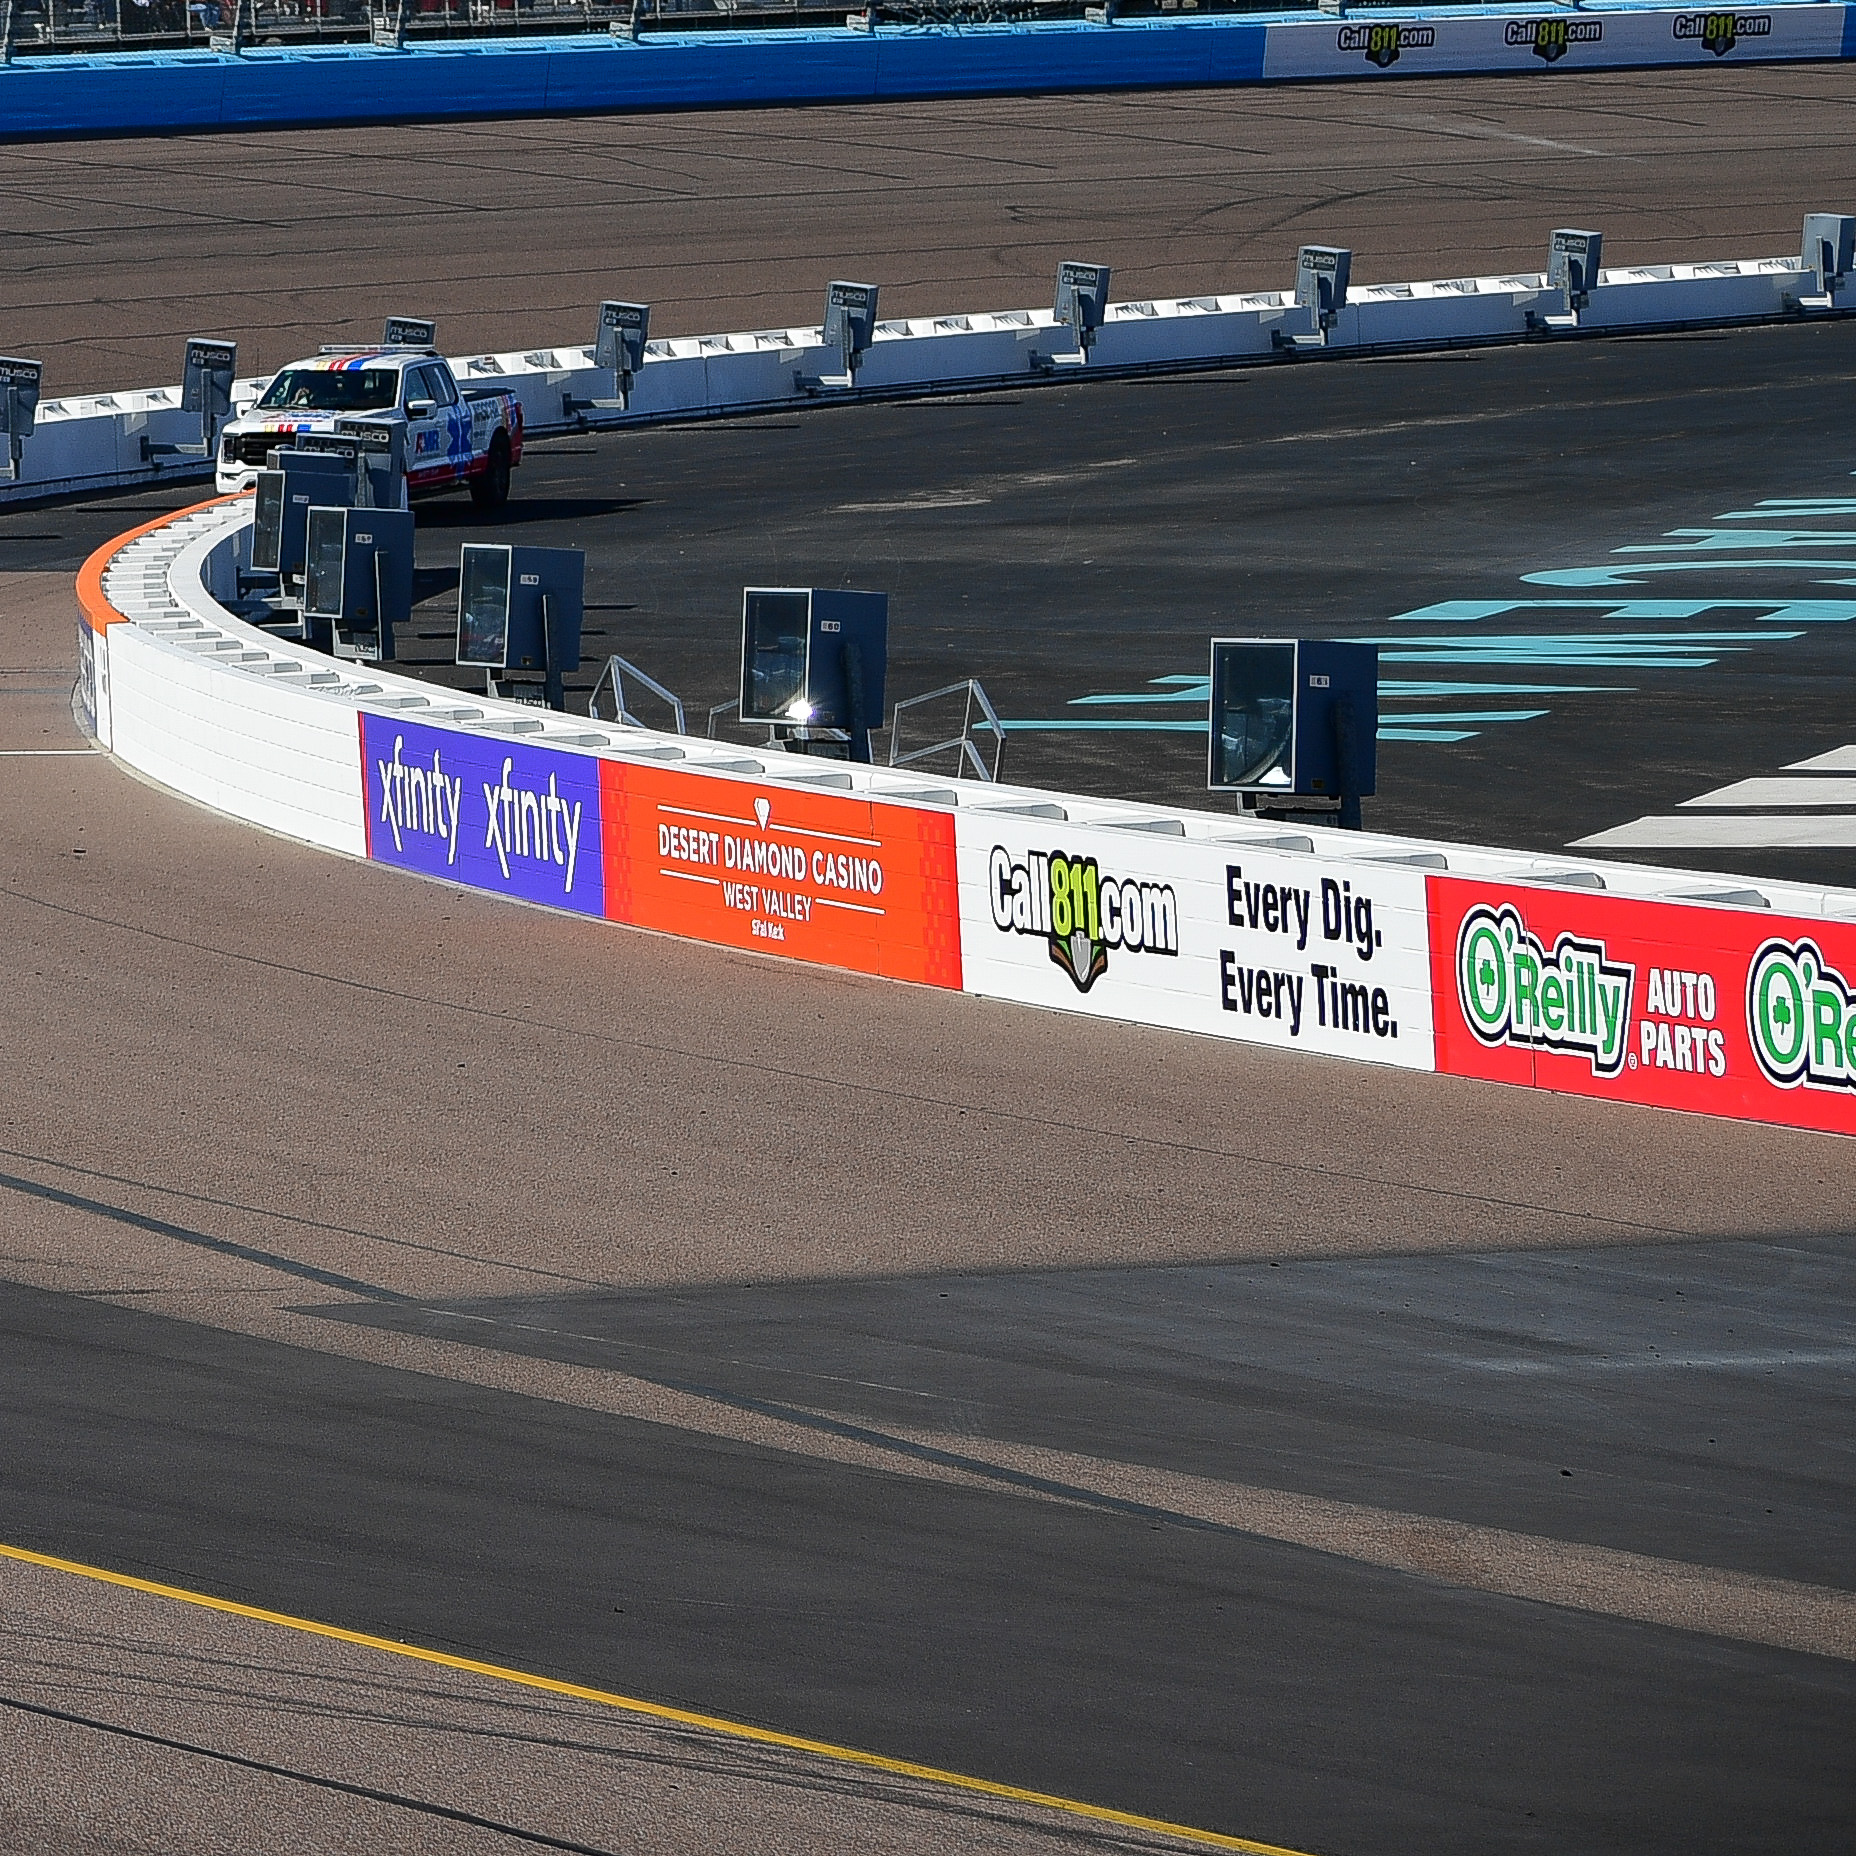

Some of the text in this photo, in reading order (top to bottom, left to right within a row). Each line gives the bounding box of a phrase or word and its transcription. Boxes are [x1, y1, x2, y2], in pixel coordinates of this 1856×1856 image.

[1338, 24, 1436, 52] Call811.com
[1505, 18, 1604, 47] Call811.com
[1673, 11, 1772, 40] Call811.com
[341, 430, 390, 442] musco
[376, 733, 583, 894] xfinity xfinity
[657, 822, 883, 896] DESERT DIAMOND CASINO
[722, 880, 813, 923] WEST VALLEY
[990, 845, 1179, 957] Call811.com
[1225, 864, 1383, 961] Every Dig.
[1219, 949, 1398, 1039] Every Time.
[1466, 925, 1622, 1055] O'Reilly
[1646, 966, 1716, 1022] AUTO
[1641, 1018, 1726, 1078] PARTS
